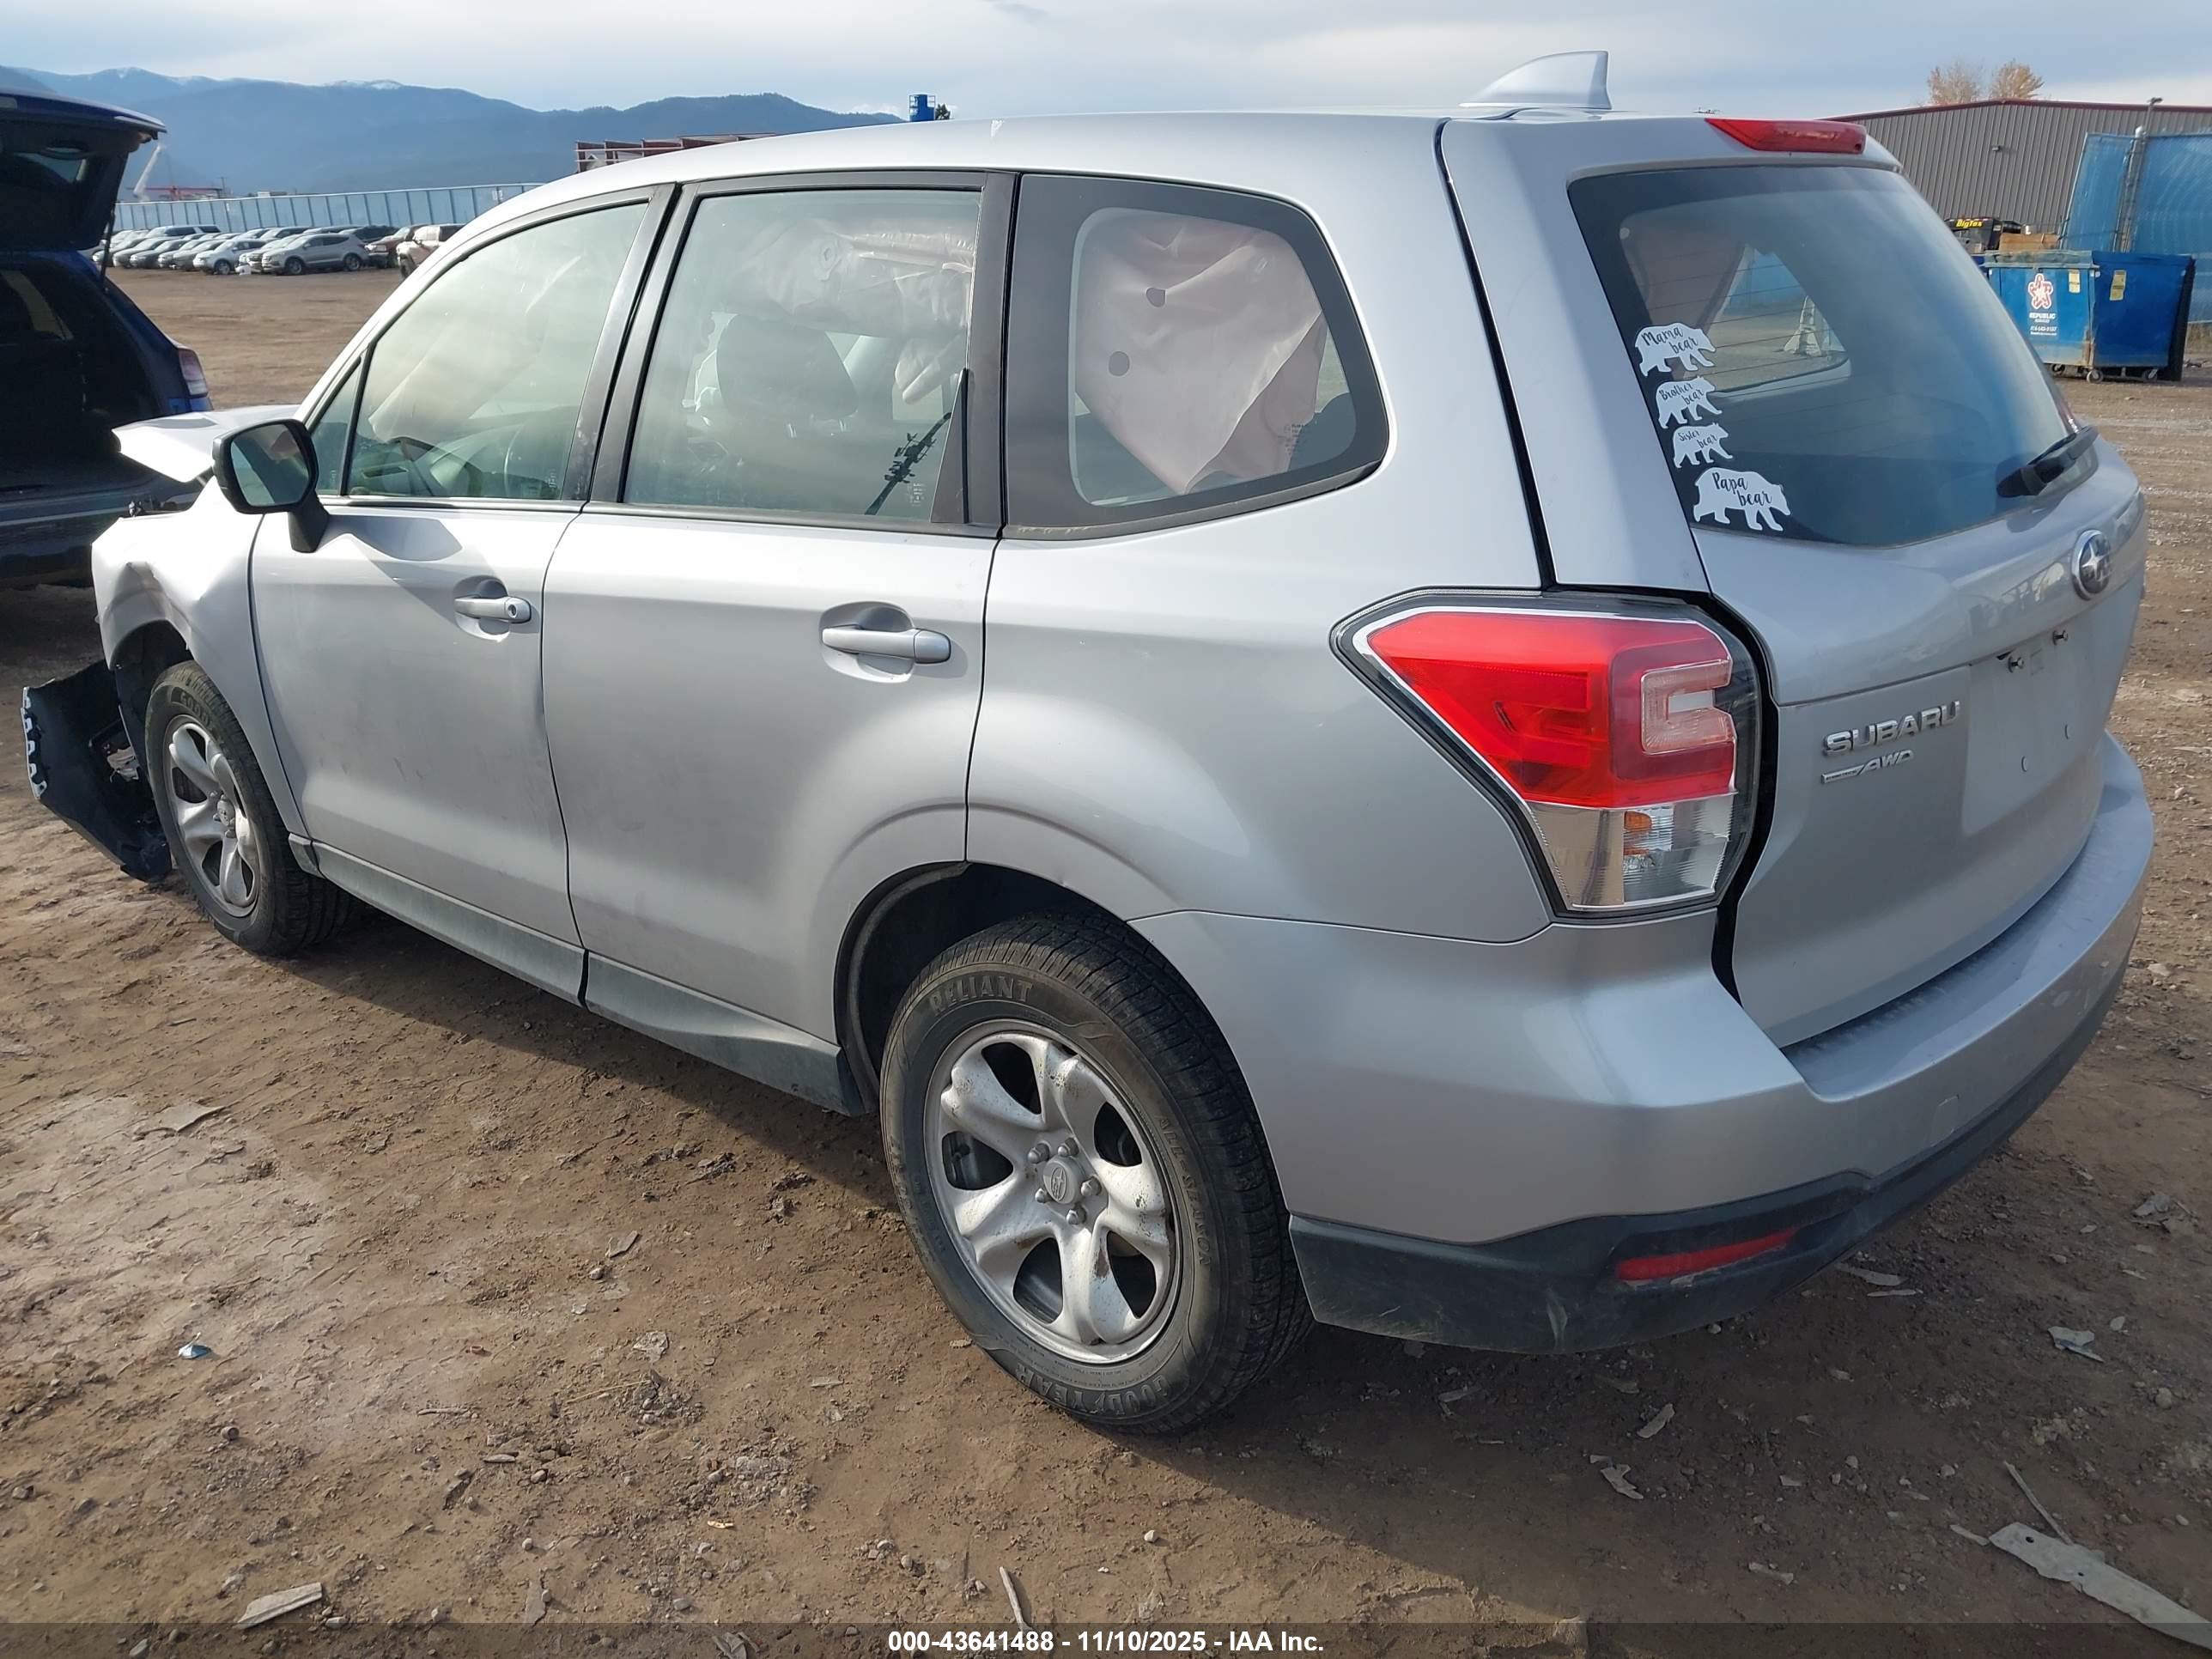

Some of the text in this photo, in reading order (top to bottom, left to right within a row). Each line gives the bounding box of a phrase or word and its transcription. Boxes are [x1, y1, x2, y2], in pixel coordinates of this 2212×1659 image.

[1641, 327, 1683, 346] Mama
[1668, 337, 1698, 354] bear
[1659, 383, 1694, 400] Brother
[1681, 389, 1705, 405] bear
[1678, 430, 1700, 441] Sister
[1697, 434, 1718, 448] bear
[1712, 472, 1747, 495] Papa
[1737, 489, 1772, 507] bear
[1823, 700, 1961, 757] SUBARU
[1858, 750, 1914, 775] AWD
